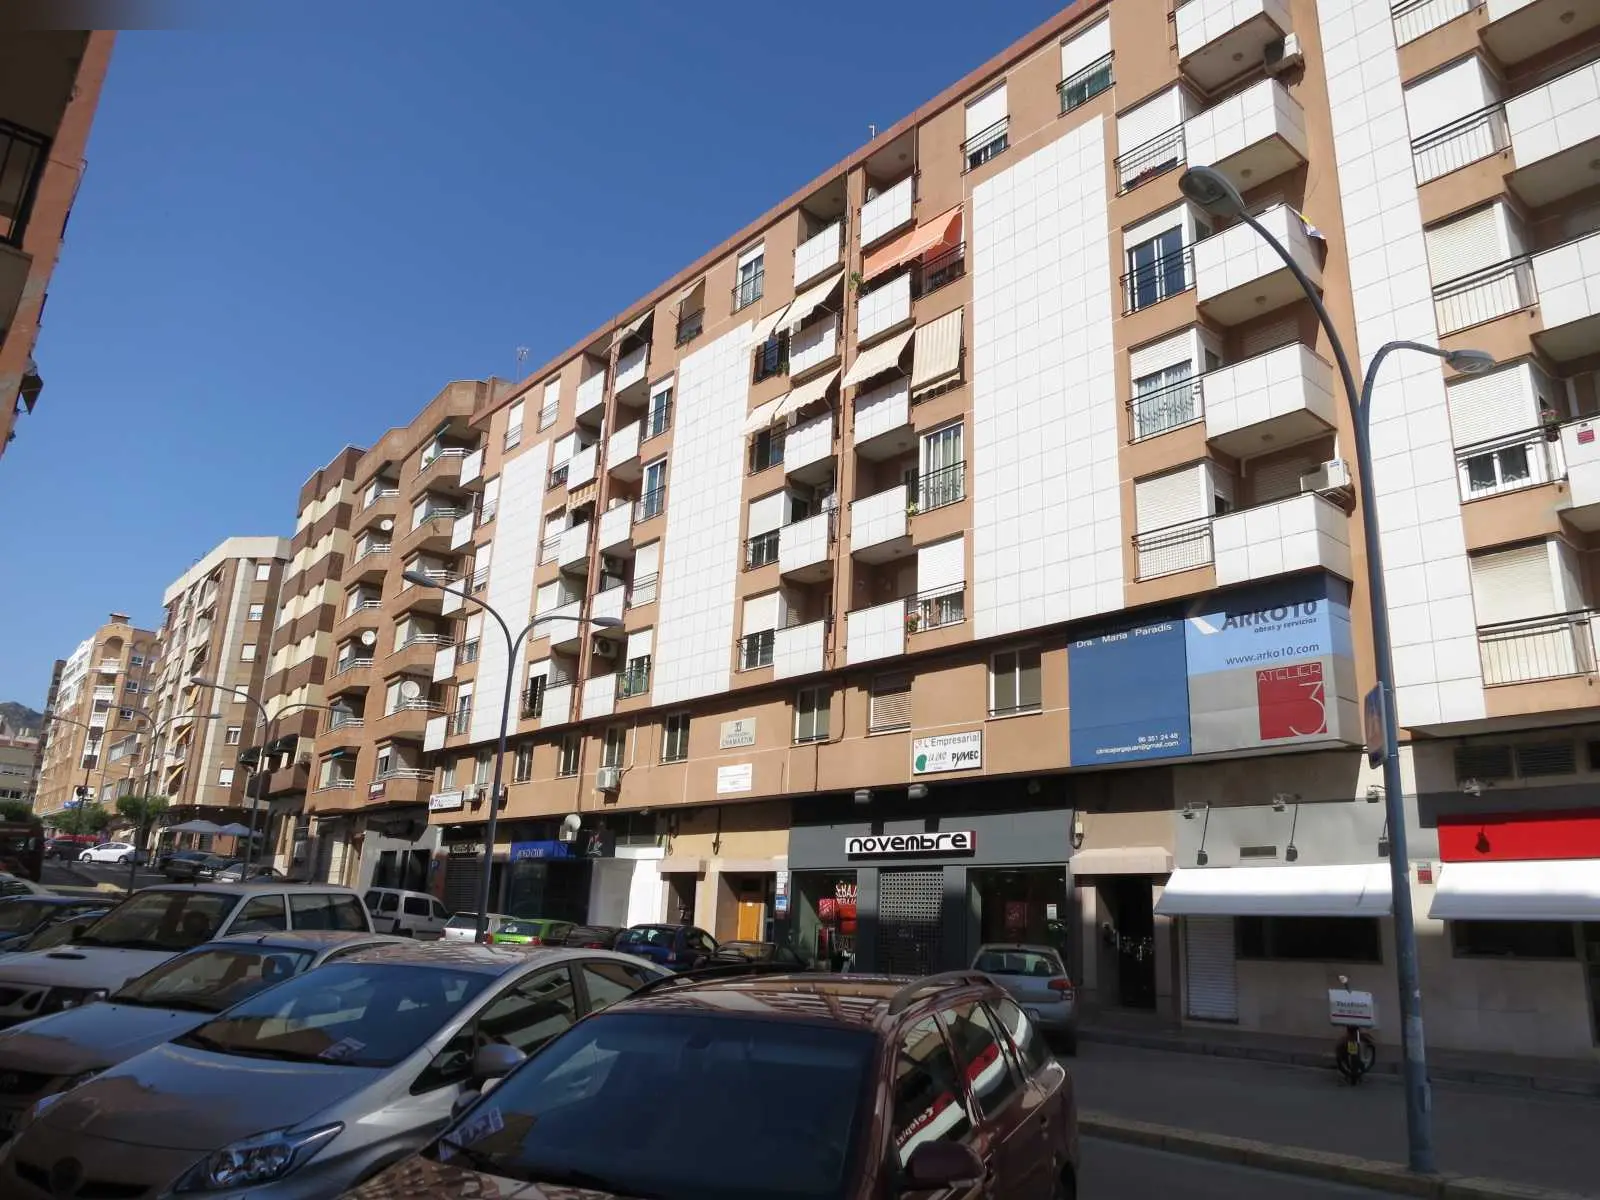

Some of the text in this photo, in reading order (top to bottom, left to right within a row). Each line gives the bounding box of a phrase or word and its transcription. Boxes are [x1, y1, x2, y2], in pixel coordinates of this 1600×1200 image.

[1221, 600, 1318, 632] ARKO10
[1254, 625, 1275, 634] obras
[1283, 617, 1318, 629] servicios
[1226, 643, 1320, 665] www.arko10.com
[1258, 663, 1321, 682] ATELIER
[1288, 681, 1327, 736] 3
[952, 750, 980, 768] PYMEC
[849, 833, 968, 852] novembre
